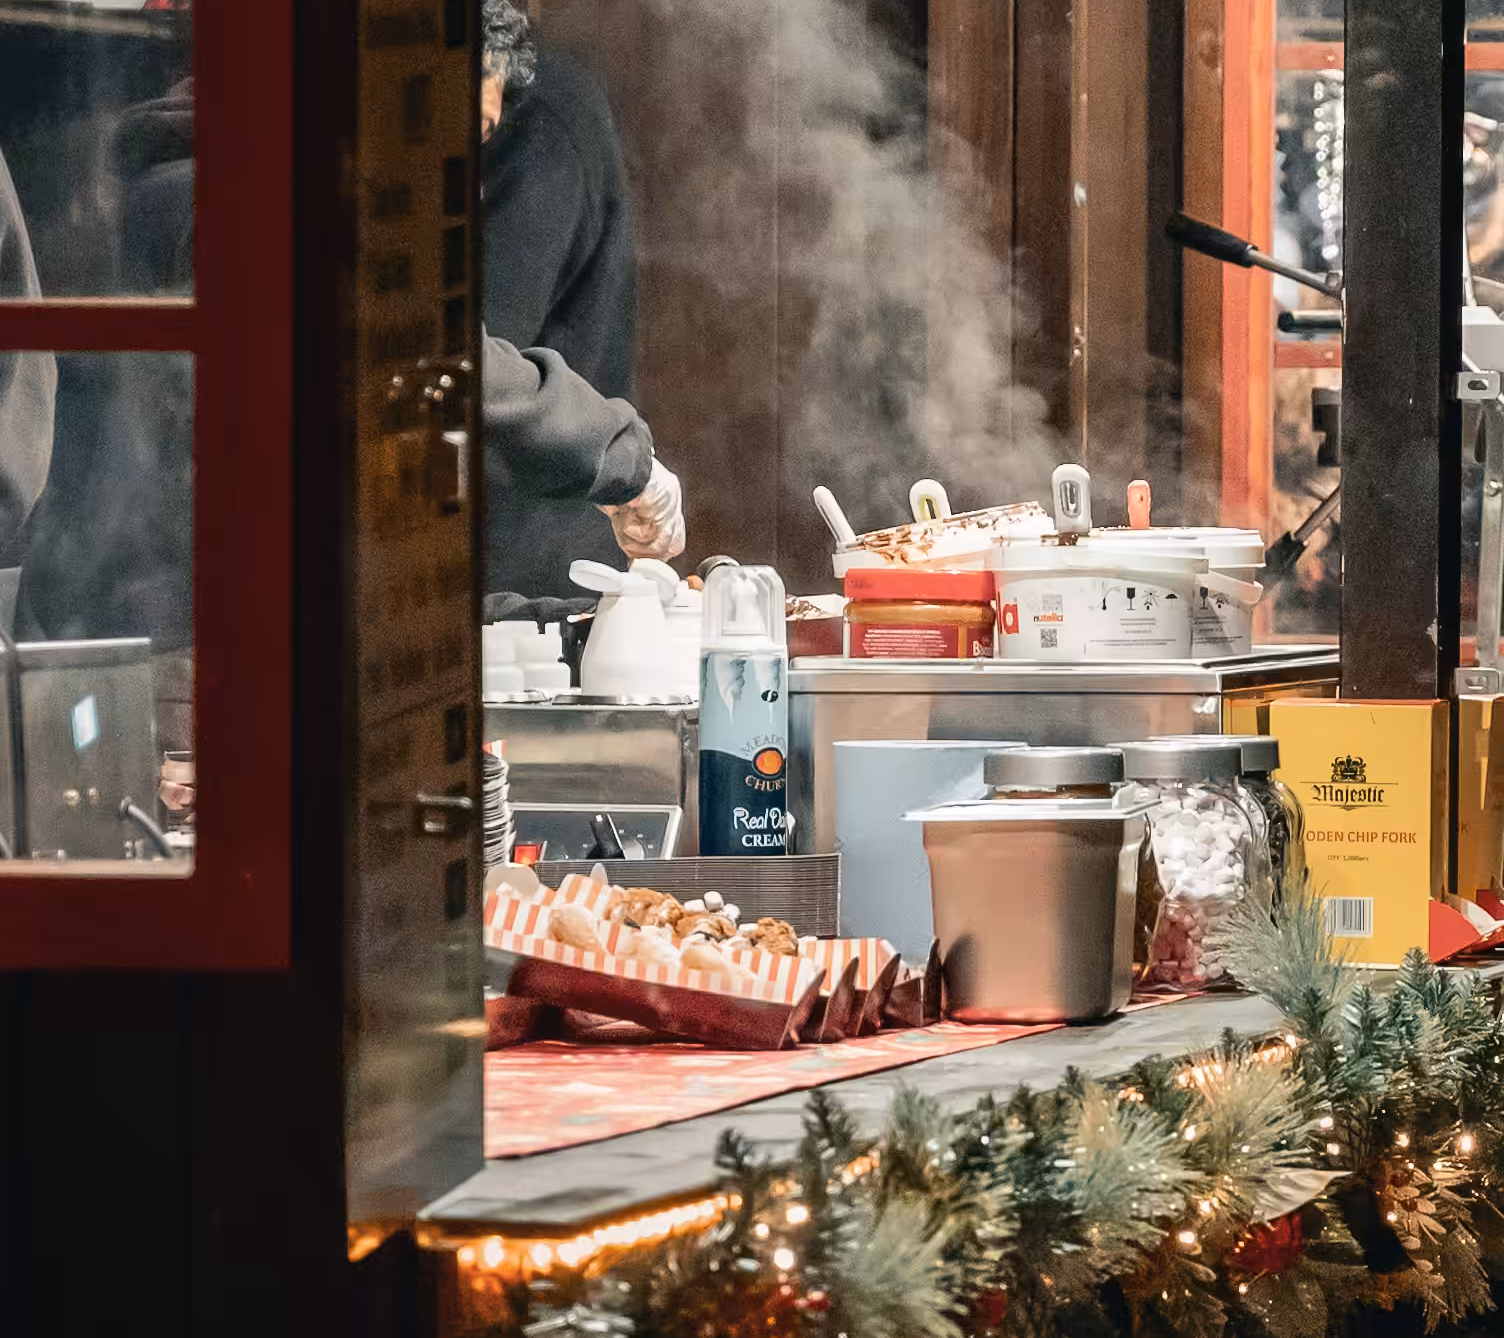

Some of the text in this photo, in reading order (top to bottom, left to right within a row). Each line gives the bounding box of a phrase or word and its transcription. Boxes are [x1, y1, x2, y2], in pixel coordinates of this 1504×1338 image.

[1311, 784, 1385, 805] Majestic
[733, 807, 769, 830] Real
[1347, 830, 1378, 843] CHIP
[1381, 831, 1417, 844] FORK
